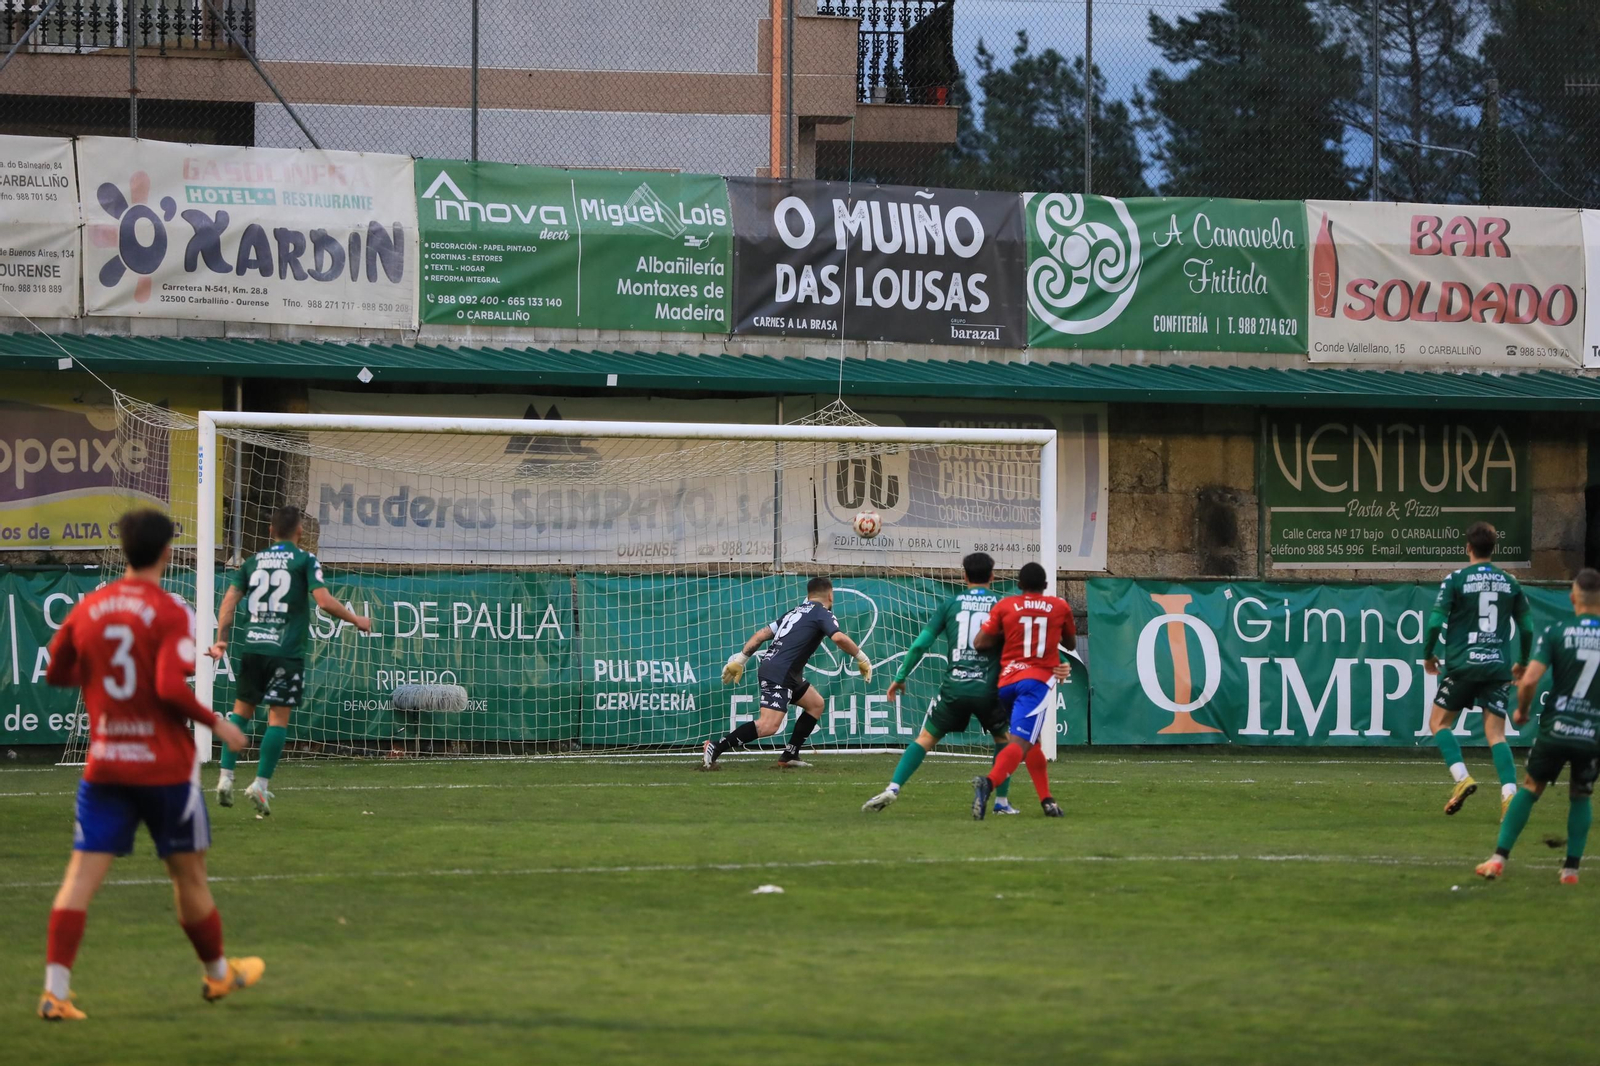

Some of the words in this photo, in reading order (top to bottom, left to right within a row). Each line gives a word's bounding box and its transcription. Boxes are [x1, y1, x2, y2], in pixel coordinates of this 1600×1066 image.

[18, 161, 52, 170] Balneario,
[0, 174, 69, 188] ARBALLIÑO
[0, 192, 15, 201] fno.
[16, 193, 29, 201] 988
[31, 193, 43, 201] 701
[282, 191, 374, 210] RESTAURANTE
[435, 196, 567, 225] innova
[581, 198, 665, 227] Miguel
[679, 201, 727, 227] Lois
[774, 196, 816, 250] O
[832, 190, 985, 259] MUIÑO
[1153, 214, 1184, 248] A
[1193, 212, 1296, 249] Canavela
[1409, 214, 1511, 258] BAR
[9, 248, 36, 257] Buenos
[38, 249, 59, 258] Aires,
[61, 250, 74, 258] 134
[430, 242, 477, 250] DECORACIÓN
[506, 245, 537, 253] PINTADO
[430, 253, 466, 261] CORTINAS
[472, 254, 503, 262] ESTORES
[636, 256, 725, 276] Albañilería
[0, 263, 61, 278] OURENSE
[430, 275, 464, 283] REFORMA
[466, 276, 501, 284] INTEGRAL
[1183, 258, 1268, 295] Fritida
[18, 284, 31, 292] 988
[33, 284, 46, 293] 318
[48, 285, 62, 293] 889
[162, 283, 202, 292] Carretera
[204, 284, 231, 295] N-541,
[232, 286, 249, 294] Km.
[250, 286, 268, 295] 28.8
[617, 278, 698, 298] Montaxes
[703, 280, 724, 299] de
[775, 263, 841, 305] DAS
[855, 266, 990, 313] LOUSAS
[160, 295, 186, 303] 32500
[188, 296, 229, 305] Carballiño
[236, 299, 270, 307] Ourense
[282, 298, 303, 308] Tfno.
[307, 300, 322, 309] 988
[325, 300, 339, 310] 271
[341, 301, 355, 310] 717
[361, 302, 376, 311] 988
[378, 302, 393, 312] 530
[437, 295, 456, 304] 988
[458, 295, 478, 305] 092
[480, 296, 499, 305] 400
[507, 297, 525, 306] 665
[528, 297, 543, 306] 133
[545, 298, 562, 307] 140
[1342, 278, 1578, 326] SOLDADO
[456, 310, 465, 319] O
[467, 309, 530, 321] CARBALLIÑO
[655, 302, 725, 322] Madeira
[753, 316, 786, 328] CARNES
[787, 318, 794, 328] A
[796, 318, 807, 329] LA
[810, 319, 838, 331] BRASA
[950, 325, 1000, 341] barazal
[1153, 313, 1208, 334] CONFITERÍA
[1228, 317, 1236, 334] T.
[1238, 317, 1256, 335] 988
[1259, 317, 1277, 335] 274
[1279, 318, 1297, 336] 620
[1314, 341, 1345, 353] Conde
[1347, 342, 1391, 356] Vallellano,
[1395, 344, 1405, 354] 15
[1419, 345, 1427, 355] O
[1428, 344, 1482, 356] CARBALLIÑO
[1519, 347, 1535, 357] 988
[1536, 347, 1547, 357] 53
[1272, 422, 1517, 493] VENTURA
[319, 483, 497, 530] Maderas
[938, 504, 1041, 523] CONSTRUCCIONES
[1347, 498, 1383, 518] Pasta
[1386, 500, 1401, 521] &
[1404, 498, 1440, 518] Pizza
[27, 522, 50, 540] de
[62, 522, 102, 539] ALTA
[1282, 528, 1304, 540] Calle
[1306, 529, 1332, 540] Cerca
[1334, 529, 1347, 539] Nº
[1350, 528, 1360, 539] 17
[1363, 528, 1384, 541] bajo
[1391, 528, 1399, 539] O
[1401, 526, 1460, 539] CARBALLIÑO
[617, 541, 678, 557] OURENSE
[721, 541, 742, 556] 988
[834, 533, 894, 548] EDIFICACIÓN
[898, 537, 903, 548] Y
[908, 537, 934, 549] OBRA
[936, 538, 961, 549] CIVIL
[974, 543, 988, 552] 988
[990, 543, 1004, 552] 214
[1006, 543, 1020, 552] 443
[1026, 543, 1041, 553] 600
[1057, 544, 1072, 553] 909
[1307, 544, 1325, 555] 988
[1326, 544, 1344, 555] 545
[1346, 544, 1364, 555] 996
[1372, 544, 1403, 555] E-mail.
[1466, 573, 1506, 582] ABANCA
[248, 569, 291, 613] 22
[309, 601, 382, 639] SAL
[394, 601, 439, 638] DE
[453, 602, 565, 640] PAULA
[1233, 596, 1516, 645] Gimna
[1478, 592, 1498, 633] 5
[1019, 616, 1048, 658] 11
[102, 624, 137, 701] 3
[594, 657, 697, 684] PULPERÍA
[377, 670, 456, 690] RIBEIRO
[1572, 650, 1600, 699] 7
[344, 700, 391, 711] DENOMI
[595, 690, 696, 711] CERVECERÍA
[4, 704, 39, 731] de
